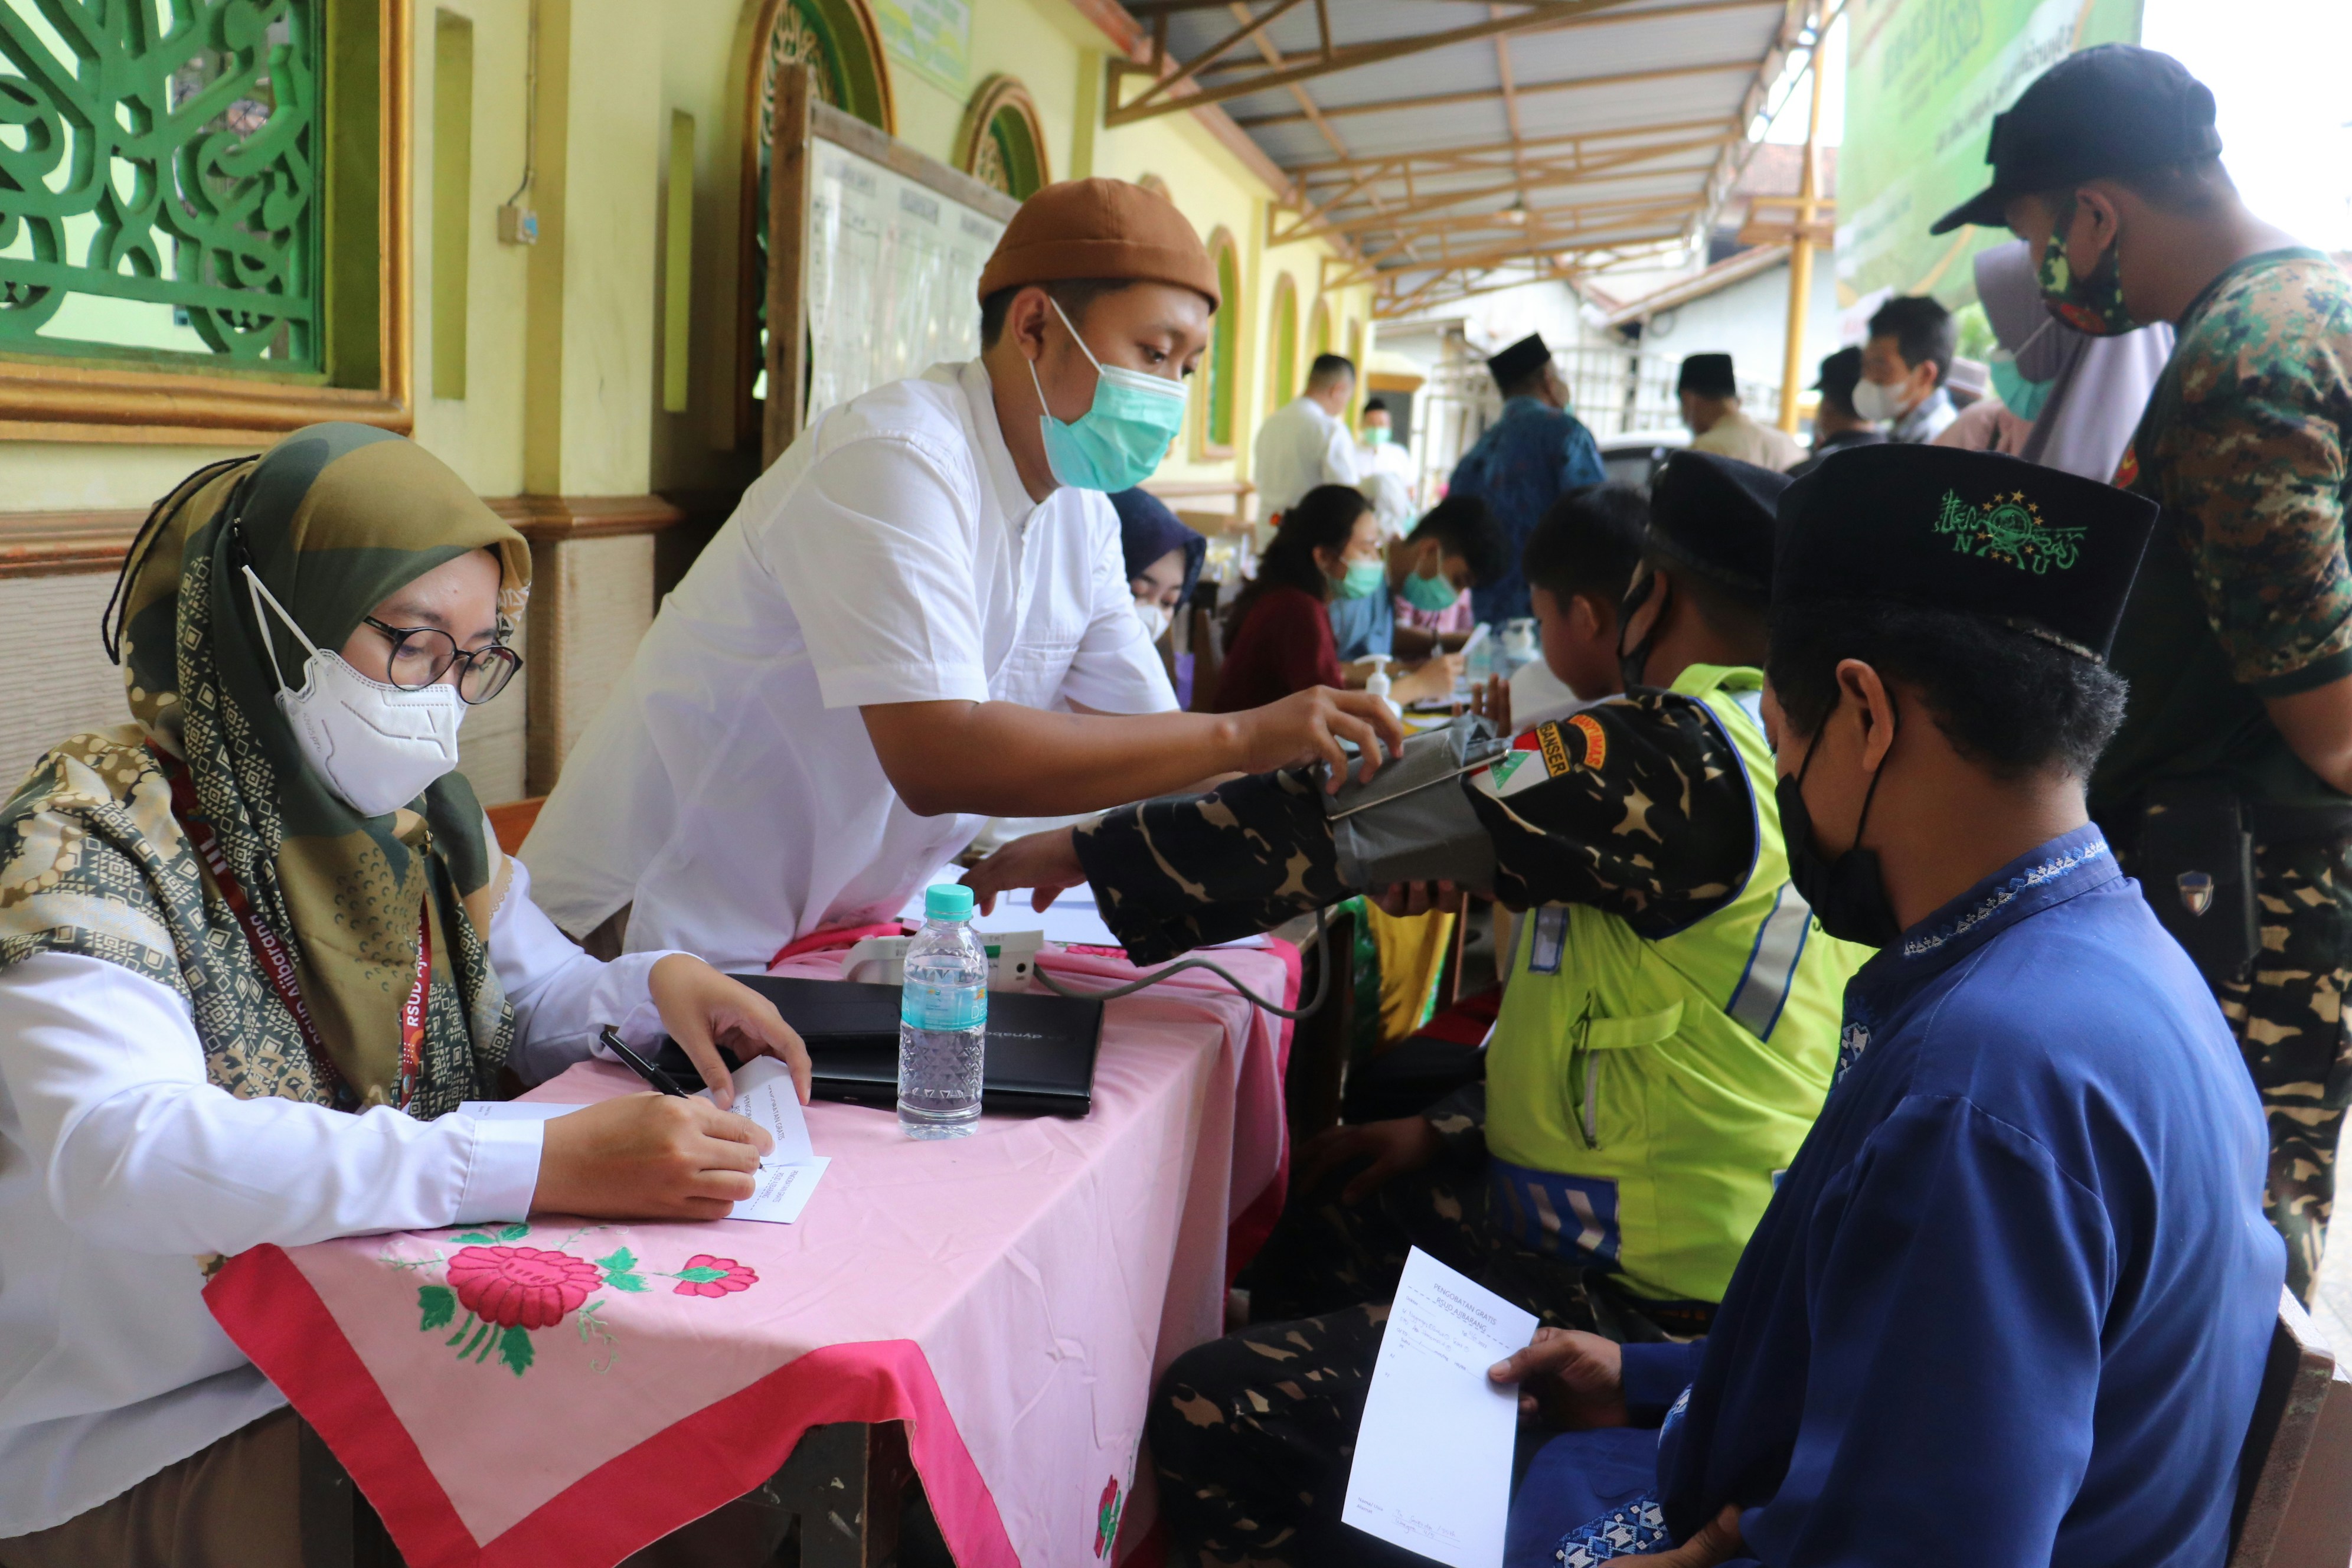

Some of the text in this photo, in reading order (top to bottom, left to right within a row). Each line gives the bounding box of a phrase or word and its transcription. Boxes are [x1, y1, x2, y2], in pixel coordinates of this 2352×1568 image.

[1539, 723, 1567, 775] BANSER
[406, 981, 422, 1027] RSUD
[986, 1031, 1043, 1039] dynabo
[744, 1095, 752, 1119] PENGOBA
[775, 1122, 785, 1141] GRATIS
[1433, 1283, 1497, 1325] PENGOBATAN GRATIS
[1436, 1297, 1453, 1311] RSUD
[1453, 1308, 1487, 1332] AJIBARANG
